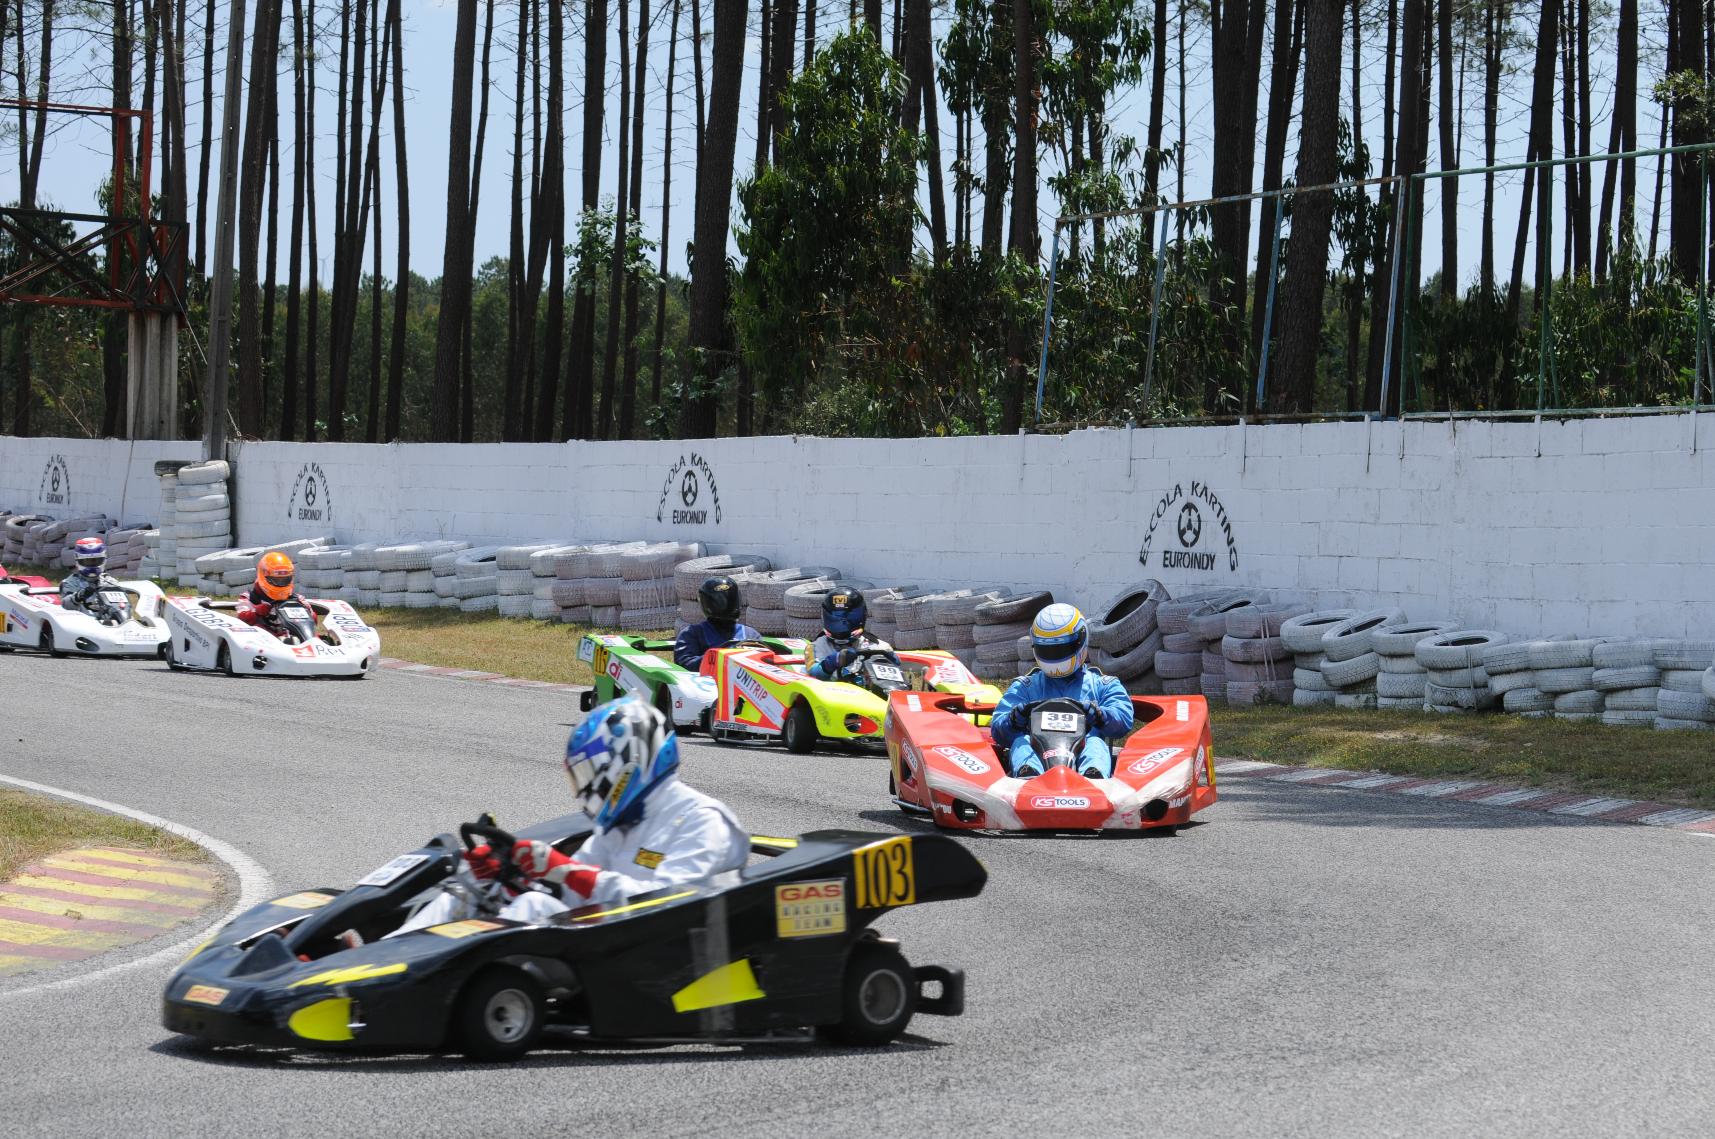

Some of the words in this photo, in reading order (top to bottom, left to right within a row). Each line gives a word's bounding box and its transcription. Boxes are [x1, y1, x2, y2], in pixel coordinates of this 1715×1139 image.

[657, 455, 686, 523] ESCOLA
[691, 452, 722, 525] KARTING
[672, 509, 708, 525] EUROINDY
[1139, 483, 1183, 567] ESCOLA
[1191, 480, 1239, 572] KARTING
[1162, 550, 1216, 571] EUROINDY
[736, 667, 768, 702] UNITRIP
[1047, 713, 1074, 722] 39
[955, 753, 985, 773] TOOLS
[1055, 798, 1086, 806] TOOLS
[861, 843, 910, 908] 103
[780, 884, 841, 901] GAS
